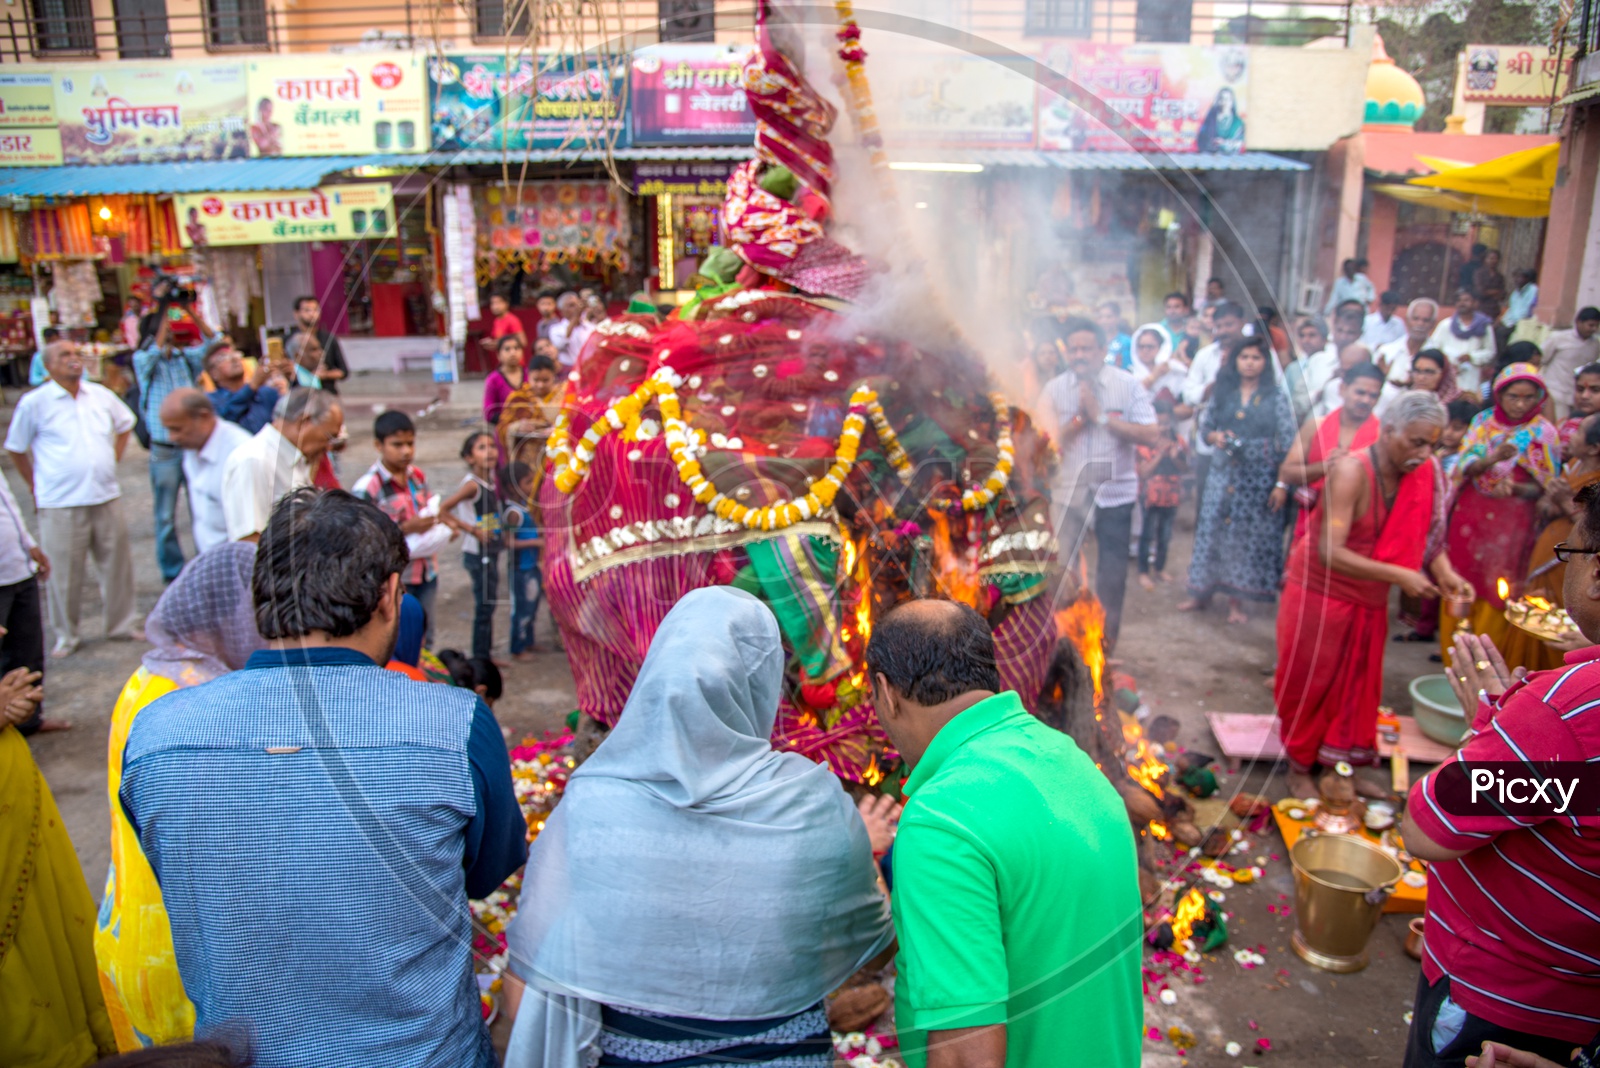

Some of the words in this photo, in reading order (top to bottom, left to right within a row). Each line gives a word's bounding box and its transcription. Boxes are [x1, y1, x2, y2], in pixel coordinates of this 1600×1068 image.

[662, 62, 694, 89] श्री
[1506, 51, 1534, 75] श्री
[82, 96, 181, 144] भुमिका
[0, 134, 33, 152] डार
